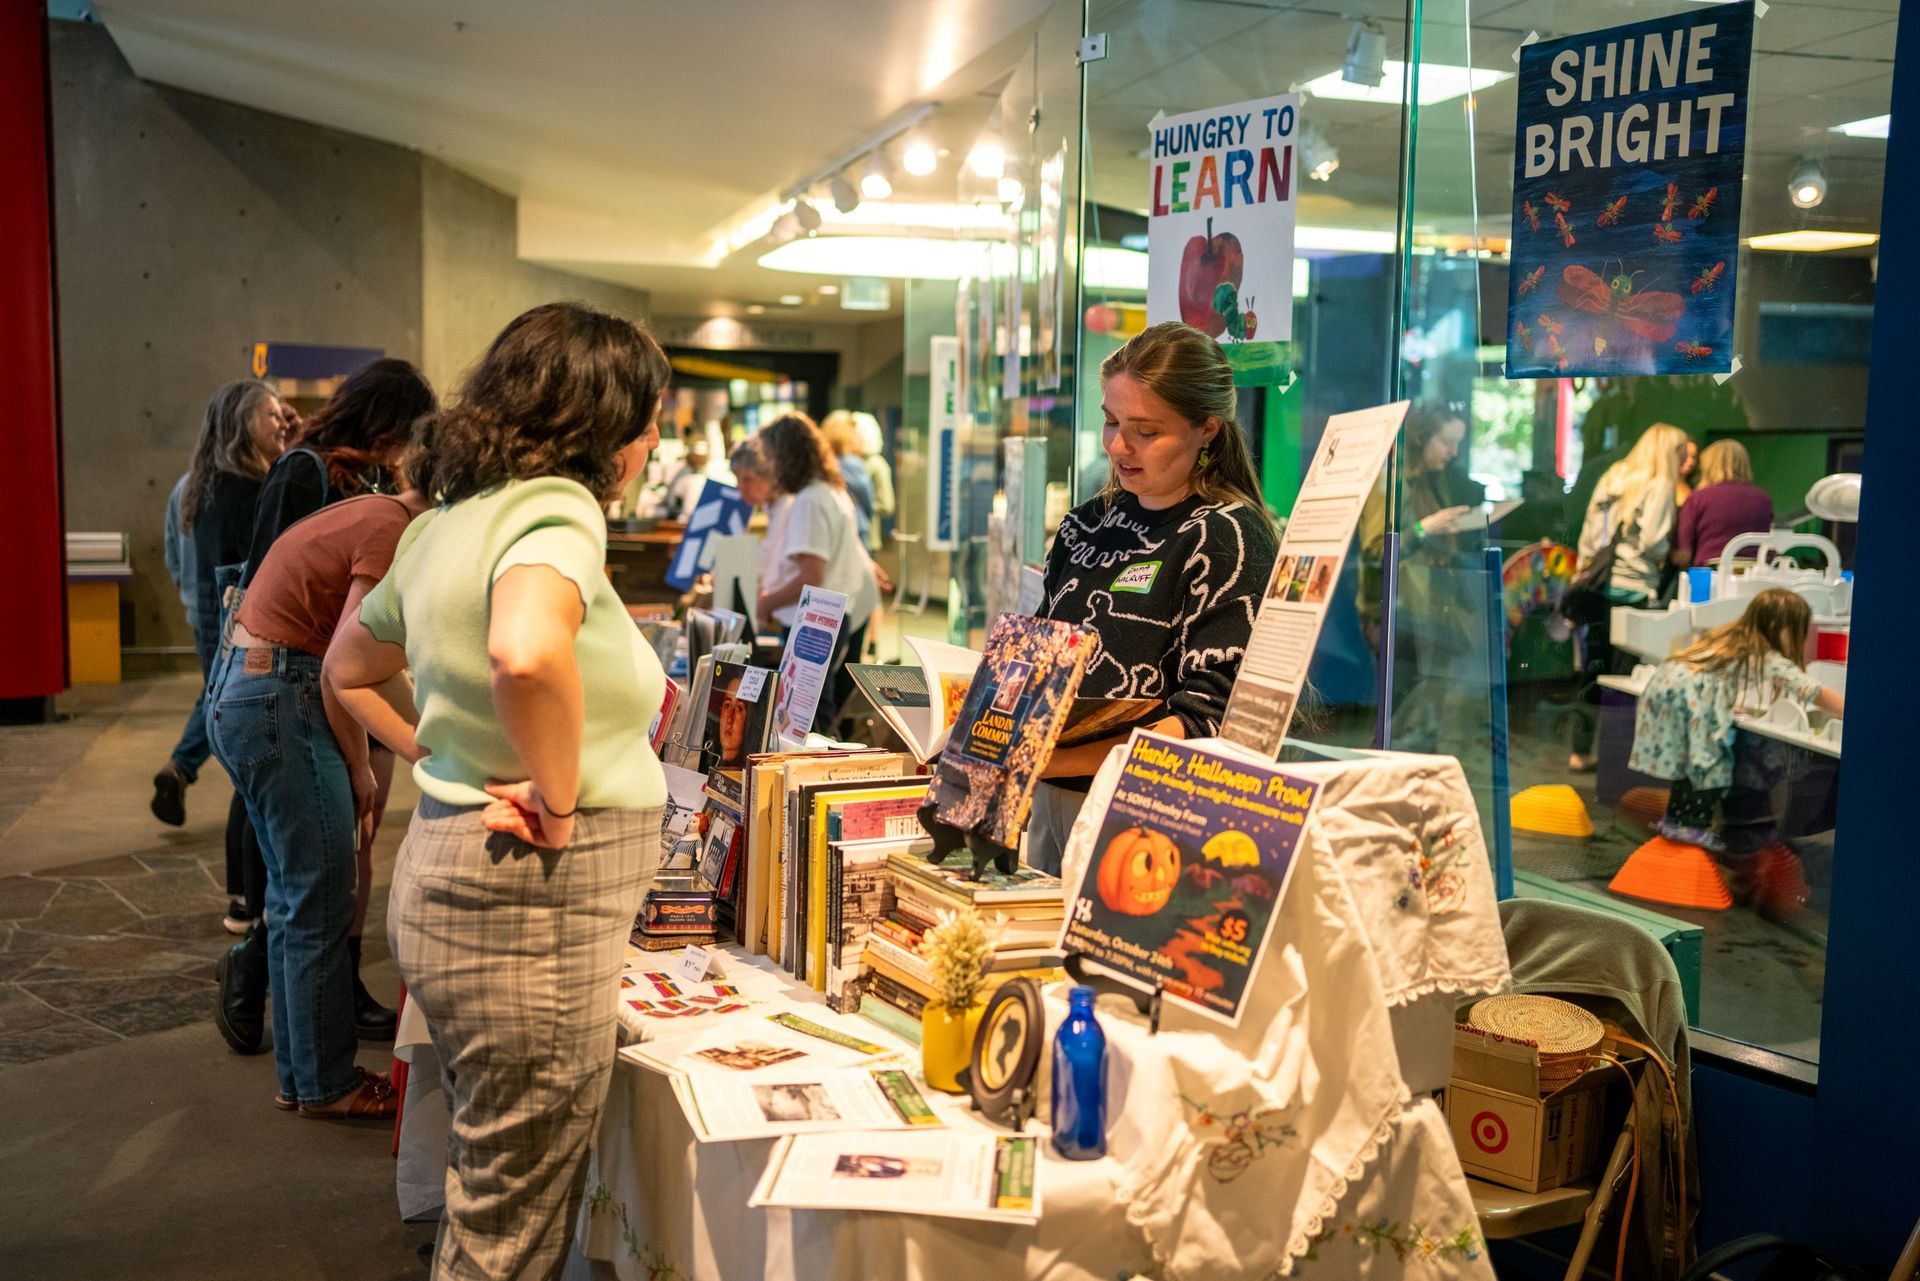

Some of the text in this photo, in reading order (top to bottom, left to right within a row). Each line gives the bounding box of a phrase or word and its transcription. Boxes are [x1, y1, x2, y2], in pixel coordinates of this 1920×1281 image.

[1547, 23, 1718, 107] SHINE
[1154, 105, 1295, 158] HUNGRY TO
[1523, 92, 1735, 179] BRIGHT
[1153, 145, 1293, 217] LEARN
[971, 721, 1013, 745] COMMON
[1124, 763, 1134, 774] A
[1196, 785, 1232, 804] twilight
[1232, 796, 1280, 819] adventure
[1280, 811, 1304, 825] walk
[1132, 738, 1312, 809] Hanley Halloween Prowl
[1151, 799, 1182, 821] Hanley
[1182, 809, 1212, 827] Farm
[1070, 919, 1111, 947] Saturday,
[1111, 935, 1150, 960] October
[1221, 915, 1248, 942] $5
